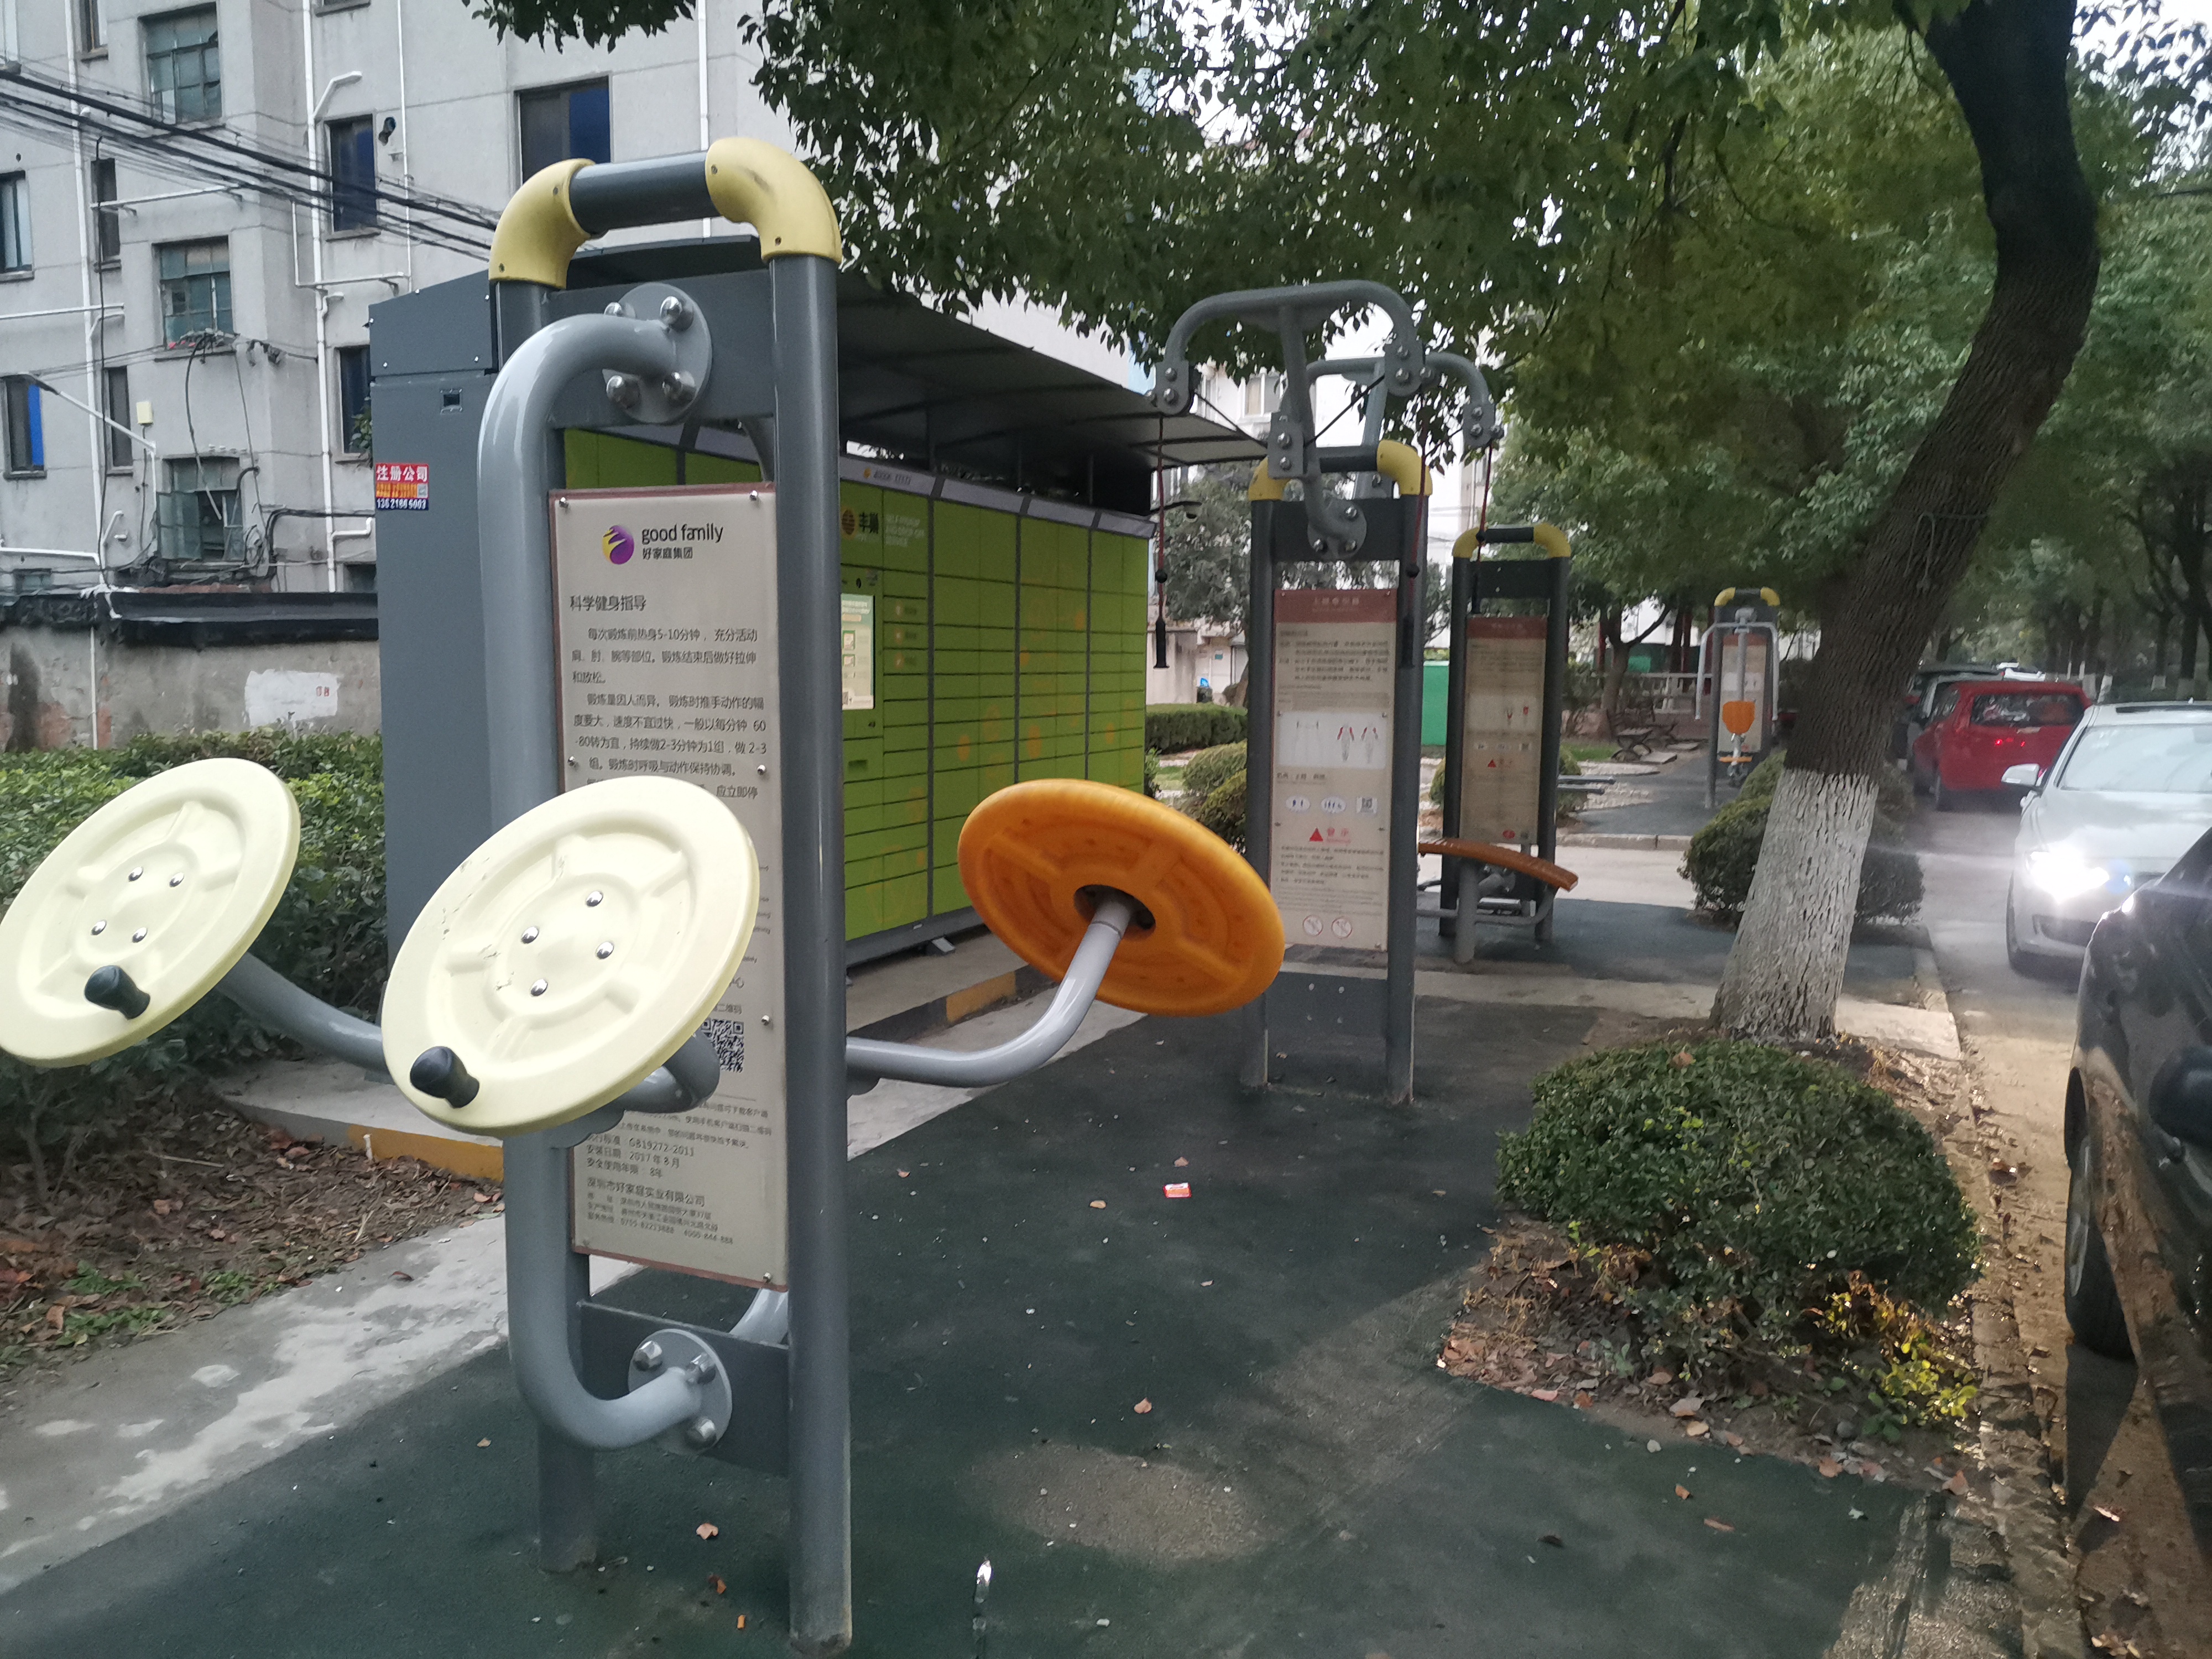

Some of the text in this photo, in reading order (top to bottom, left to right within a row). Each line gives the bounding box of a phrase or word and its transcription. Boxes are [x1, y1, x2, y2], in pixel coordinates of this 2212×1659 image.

[376, 464, 427, 482] 注册公司
[641, 522, 724, 545] good family
[642, 546, 693, 560] 好家庭集团
[570, 594, 646, 612] 科学健身指导
[713, 1003, 742, 1015] 二维码
